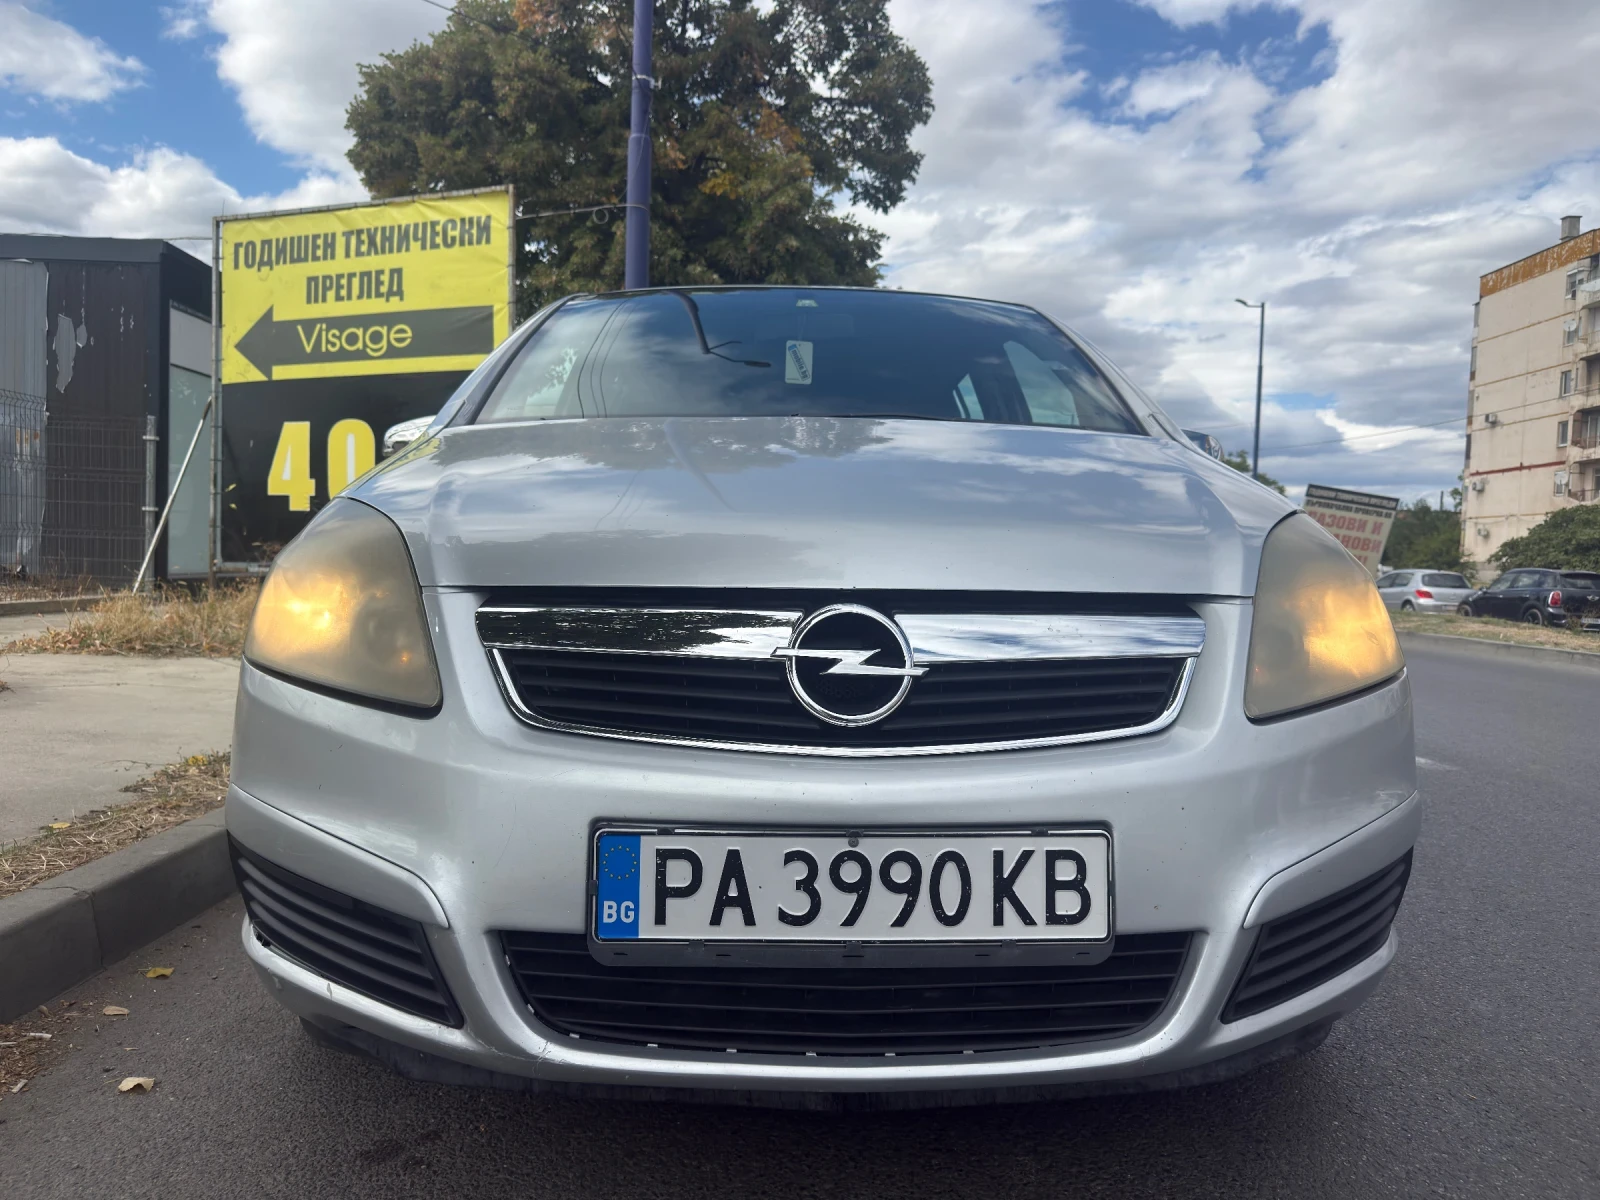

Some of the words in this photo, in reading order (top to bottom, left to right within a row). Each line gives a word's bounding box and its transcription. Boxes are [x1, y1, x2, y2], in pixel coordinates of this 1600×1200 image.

[233, 232, 337, 272] ГОДИШЕН
[342, 215, 492, 259] ТЕХНИЧЕСКИ
[306, 267, 404, 305] ПРЕГЛЕД
[297, 323, 413, 357] Visage
[267, 418, 376, 512] 40
[654, 847, 757, 927] PA
[778, 849, 972, 928] 3990
[993, 848, 1092, 927] KB
[602, 900, 635, 924] BG
